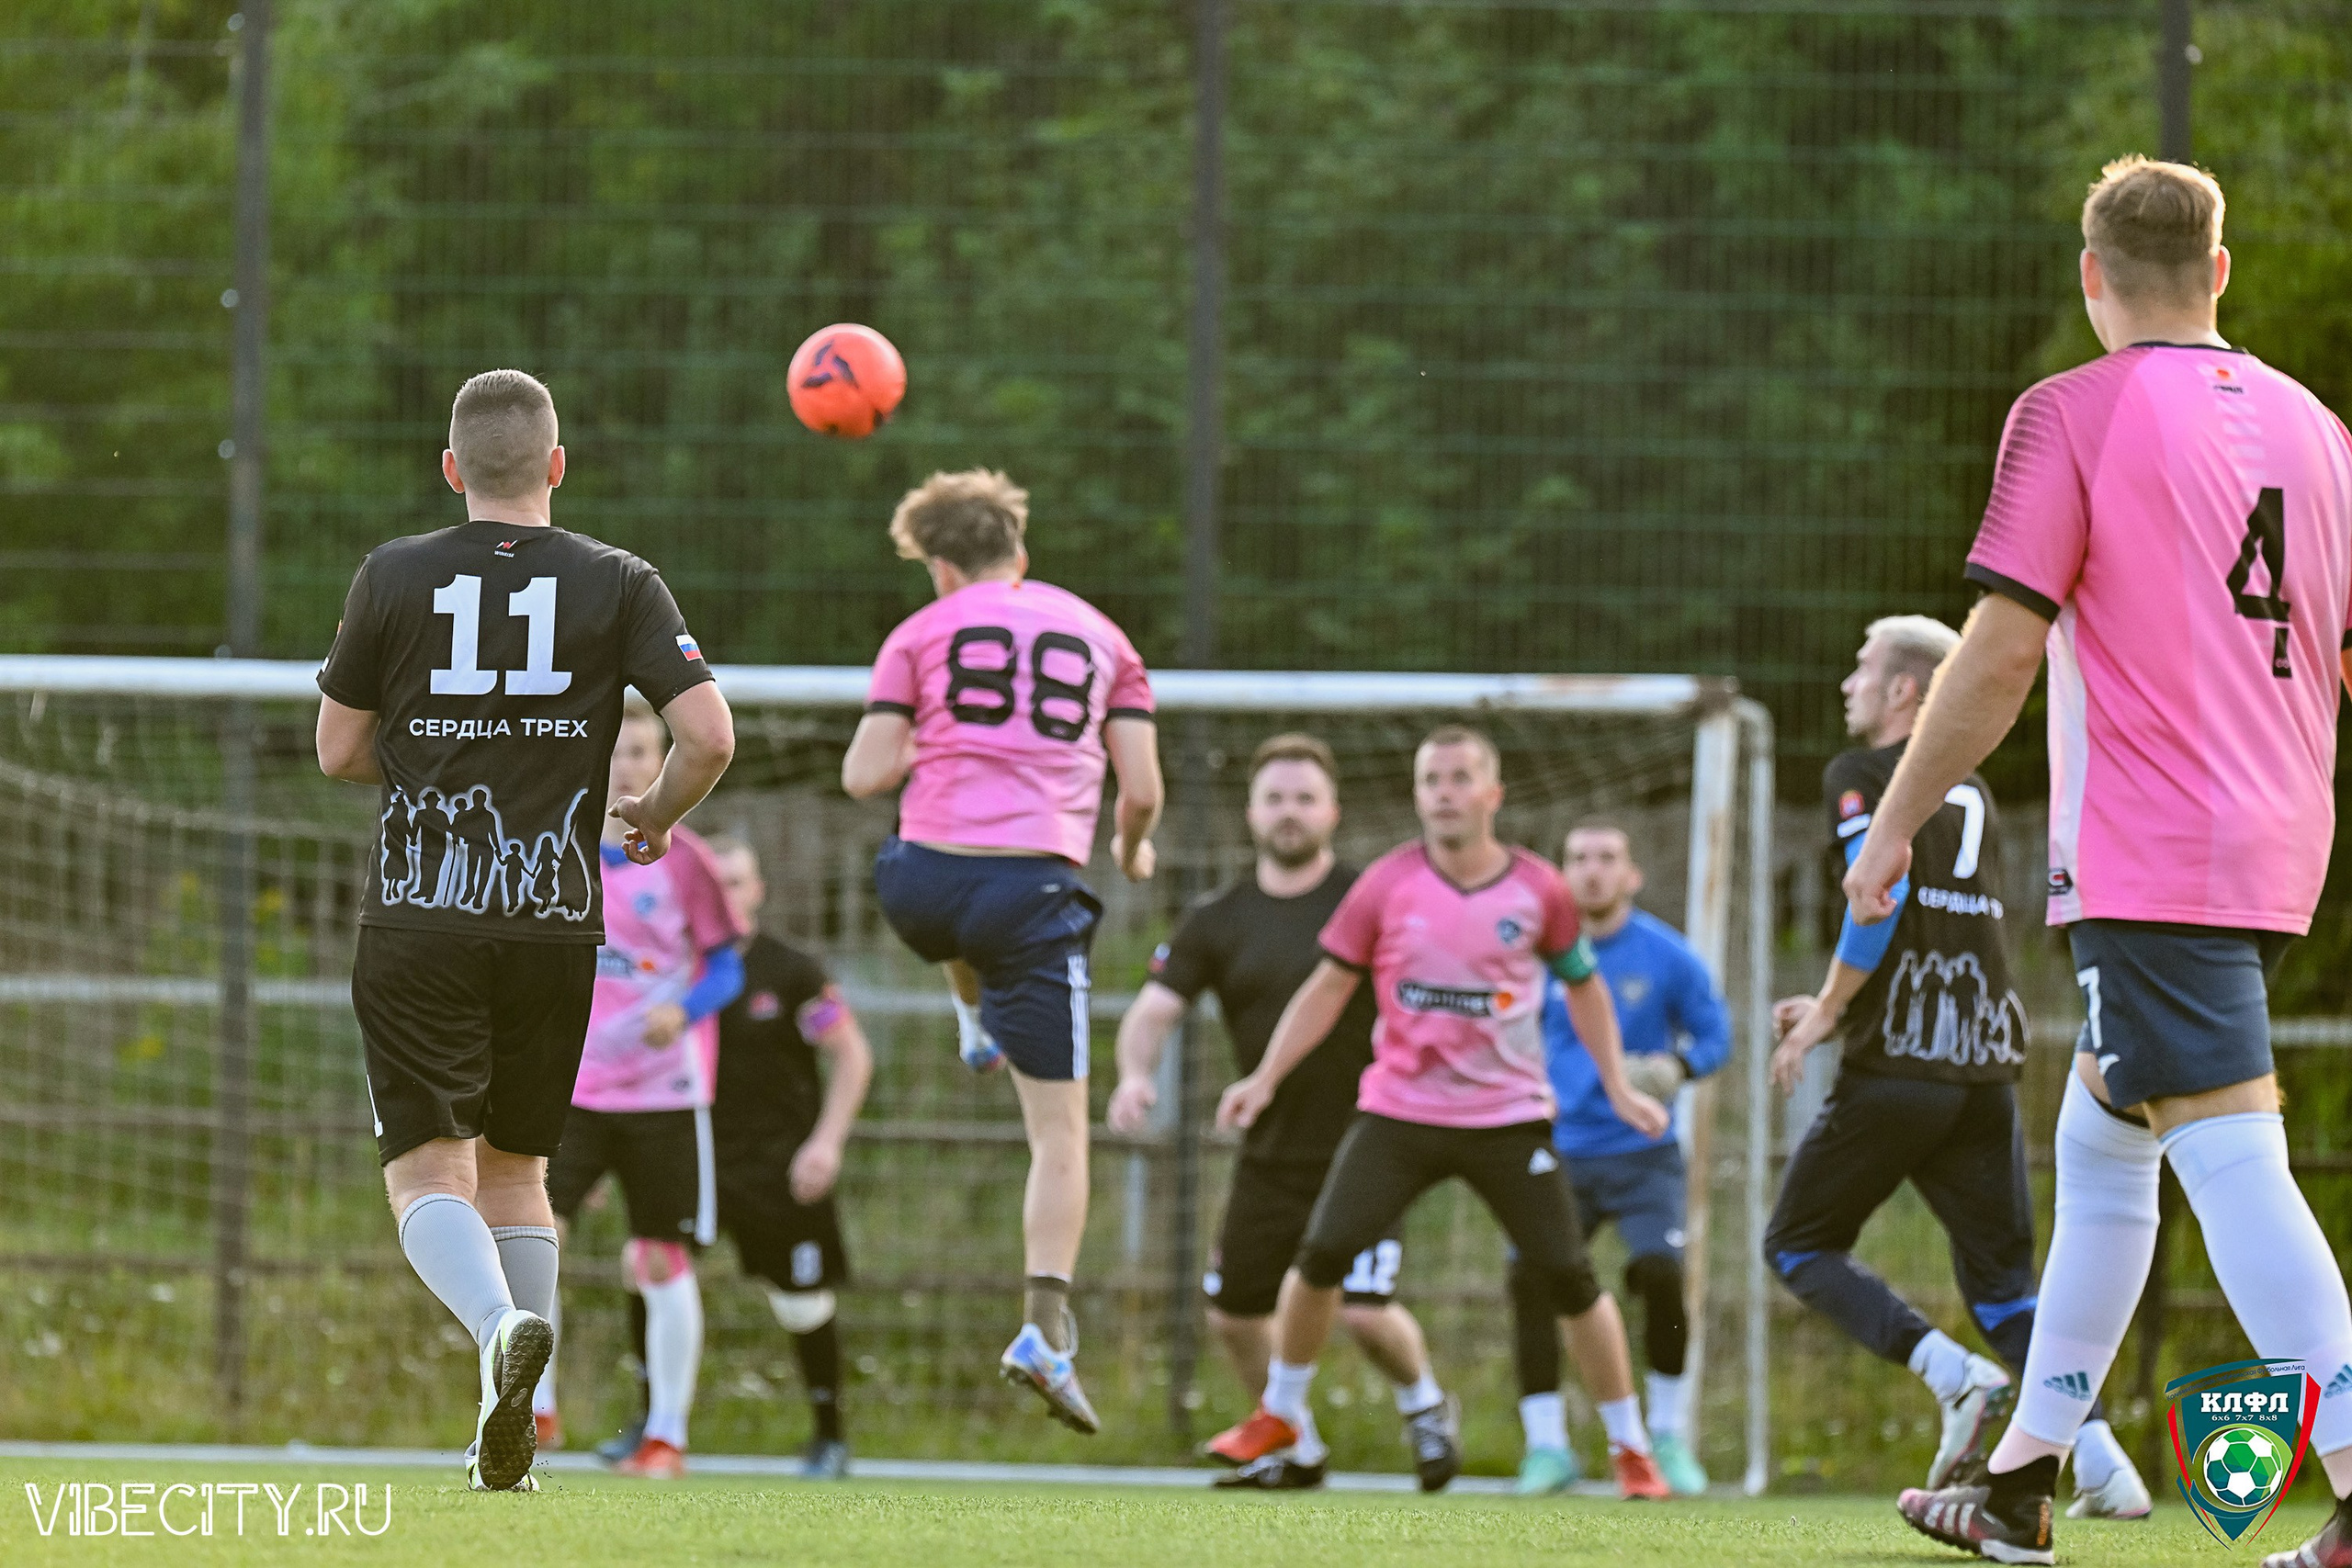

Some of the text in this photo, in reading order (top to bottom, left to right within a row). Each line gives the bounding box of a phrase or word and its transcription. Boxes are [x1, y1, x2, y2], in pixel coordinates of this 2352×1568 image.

[429, 573, 572, 695] 11
[2225, 487, 2292, 678] 4
[409, 718, 588, 739] СЕРДЦА ТРЕХ
[945, 626, 1096, 742] 88
[1944, 784, 1985, 879] 7
